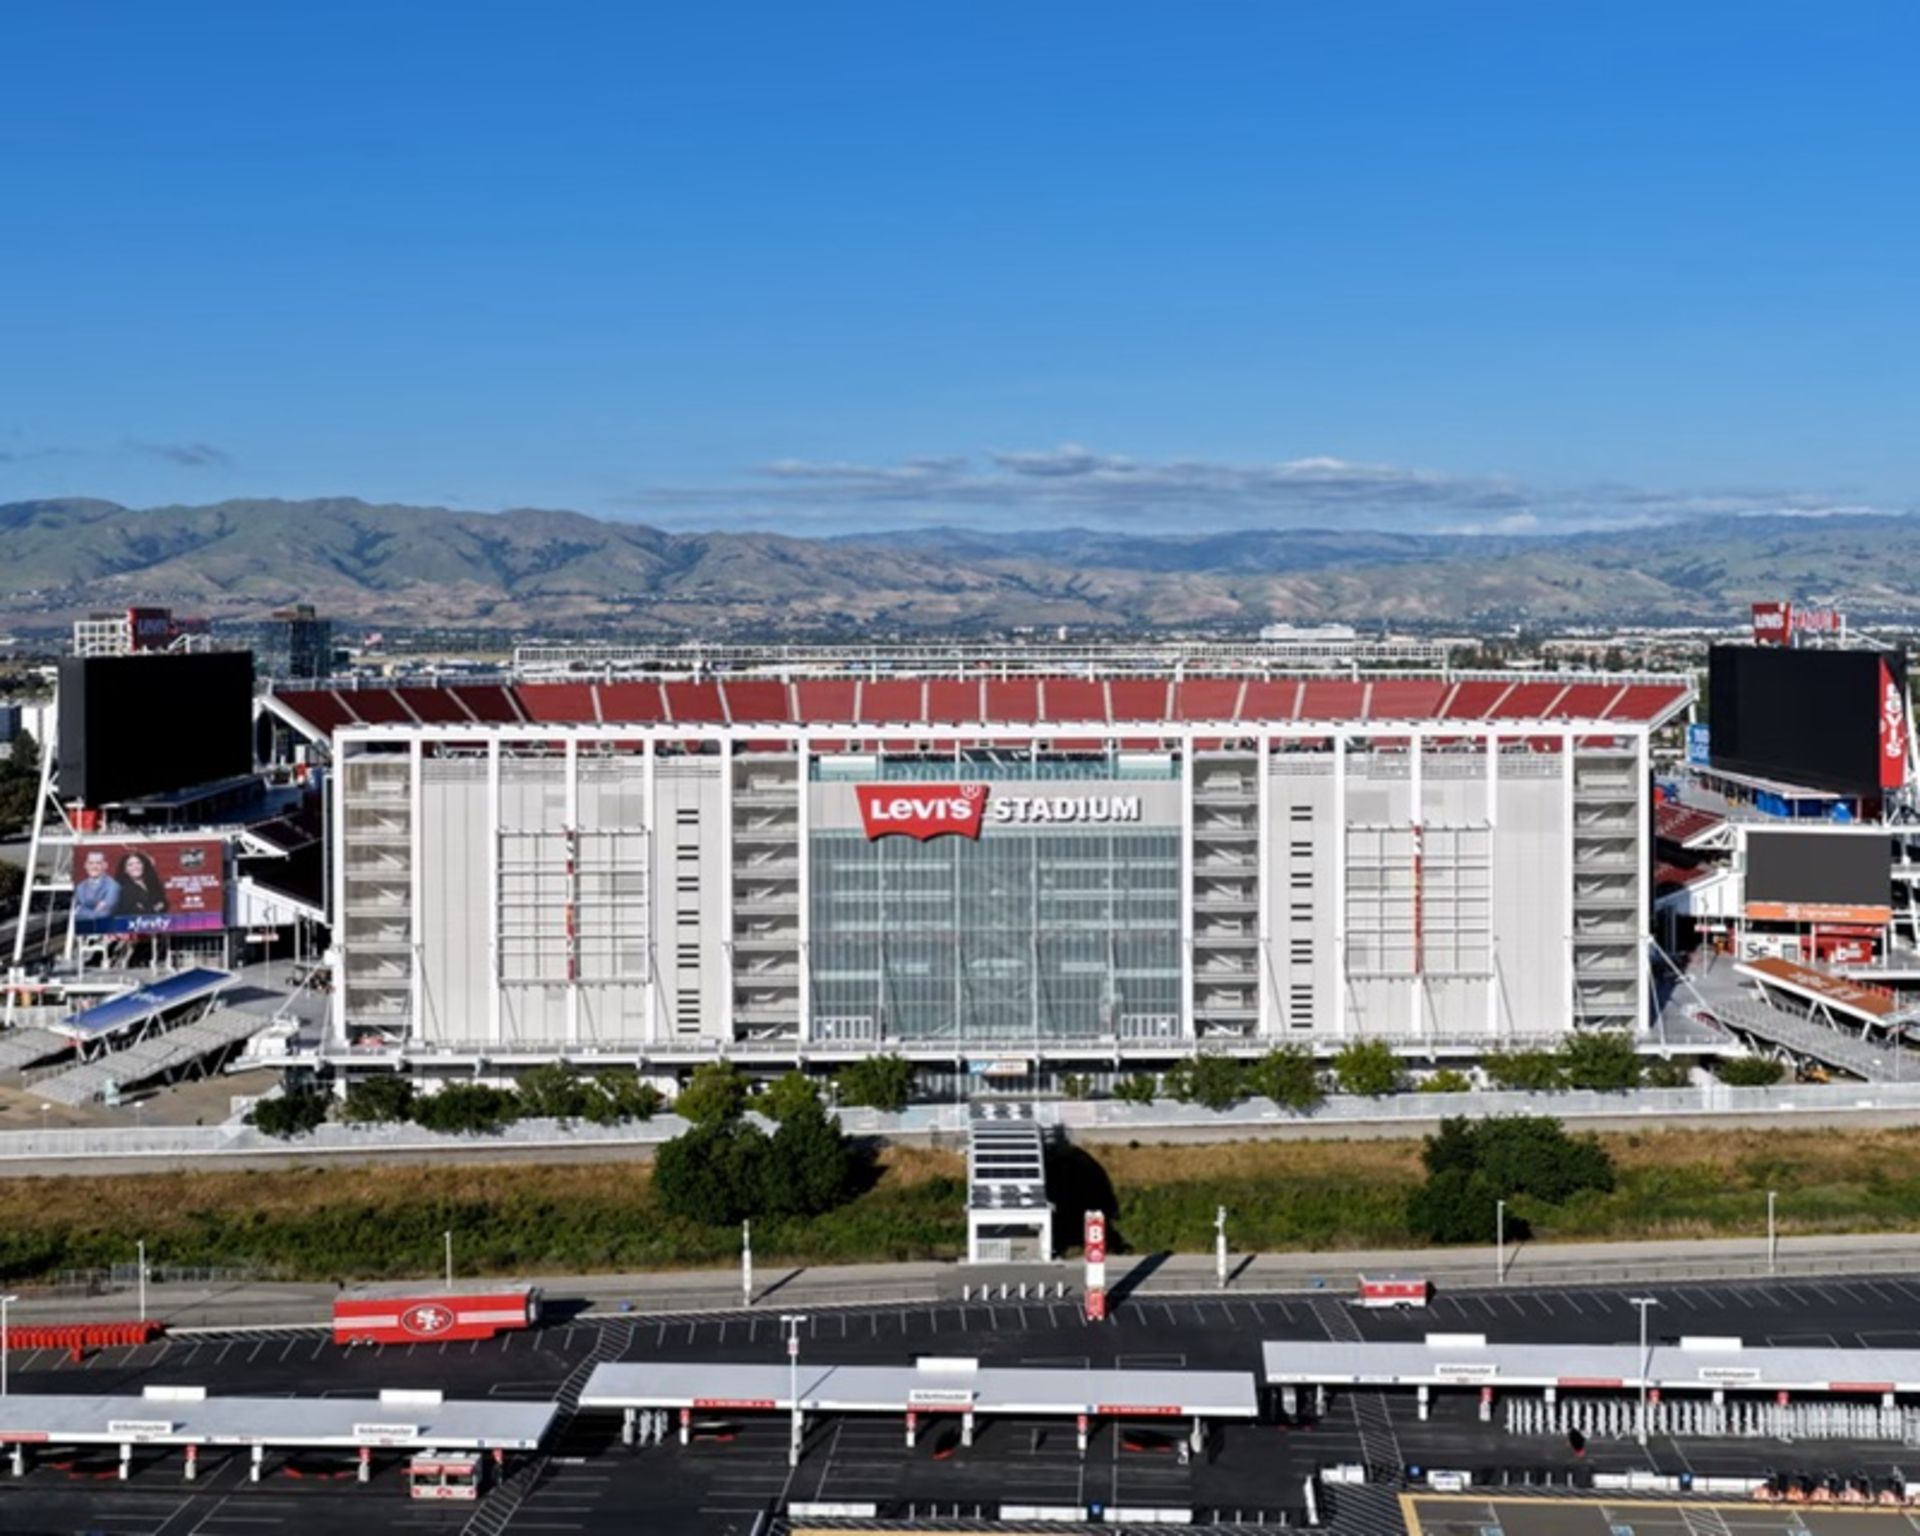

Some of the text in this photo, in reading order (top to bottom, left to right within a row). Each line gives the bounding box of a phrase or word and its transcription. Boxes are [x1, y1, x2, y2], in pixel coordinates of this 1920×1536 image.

[993, 797, 1140, 821] STADIUM
[128, 916, 171, 932] xfinity
[1088, 1225, 1103, 1244] B
